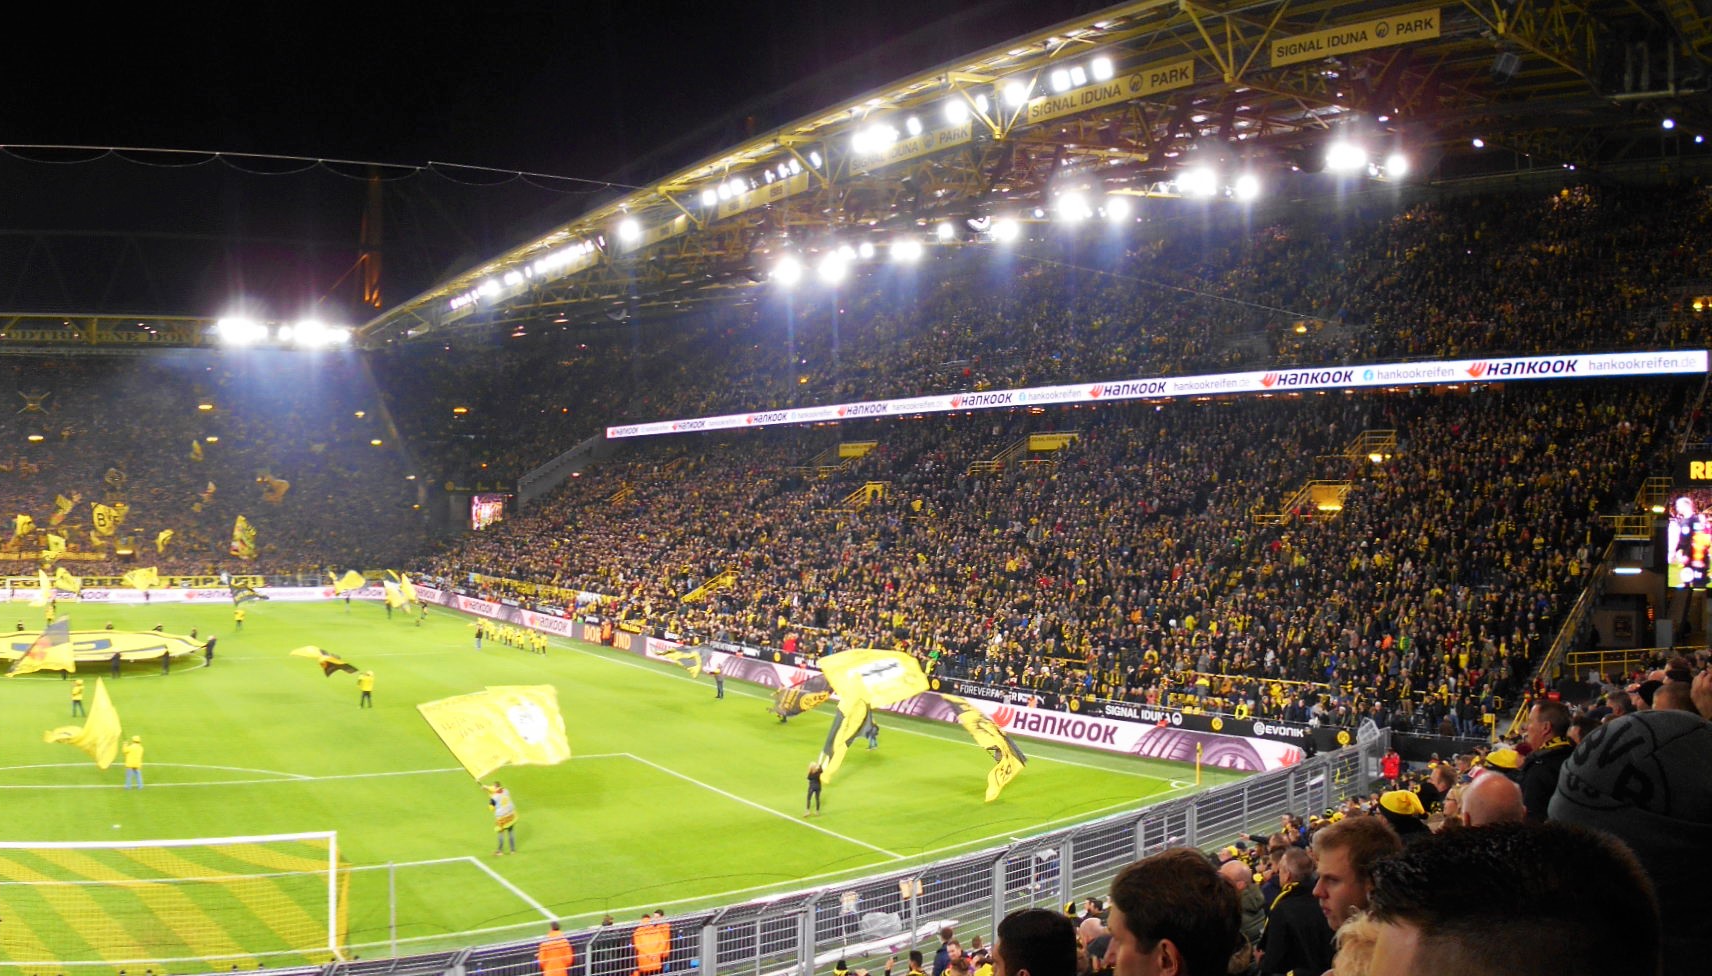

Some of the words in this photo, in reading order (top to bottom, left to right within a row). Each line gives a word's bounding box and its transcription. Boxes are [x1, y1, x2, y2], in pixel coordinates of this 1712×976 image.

[1277, 38, 1323, 58] SIGNAL
[1327, 30, 1369, 48] IDUNA
[1395, 17, 1434, 35] PARK
[1031, 97, 1077, 118] SIGNAL
[1080, 84, 1122, 104] IDUNA
[1150, 66, 1190, 88] PARK
[939, 127, 969, 144] PARK
[1377, 366, 1455, 381] hankookreifen
[1104, 705, 1140, 718] SIGNAL
[1012, 710, 1119, 745] HANKOOK
[1265, 725, 1304, 738] EVONIK
